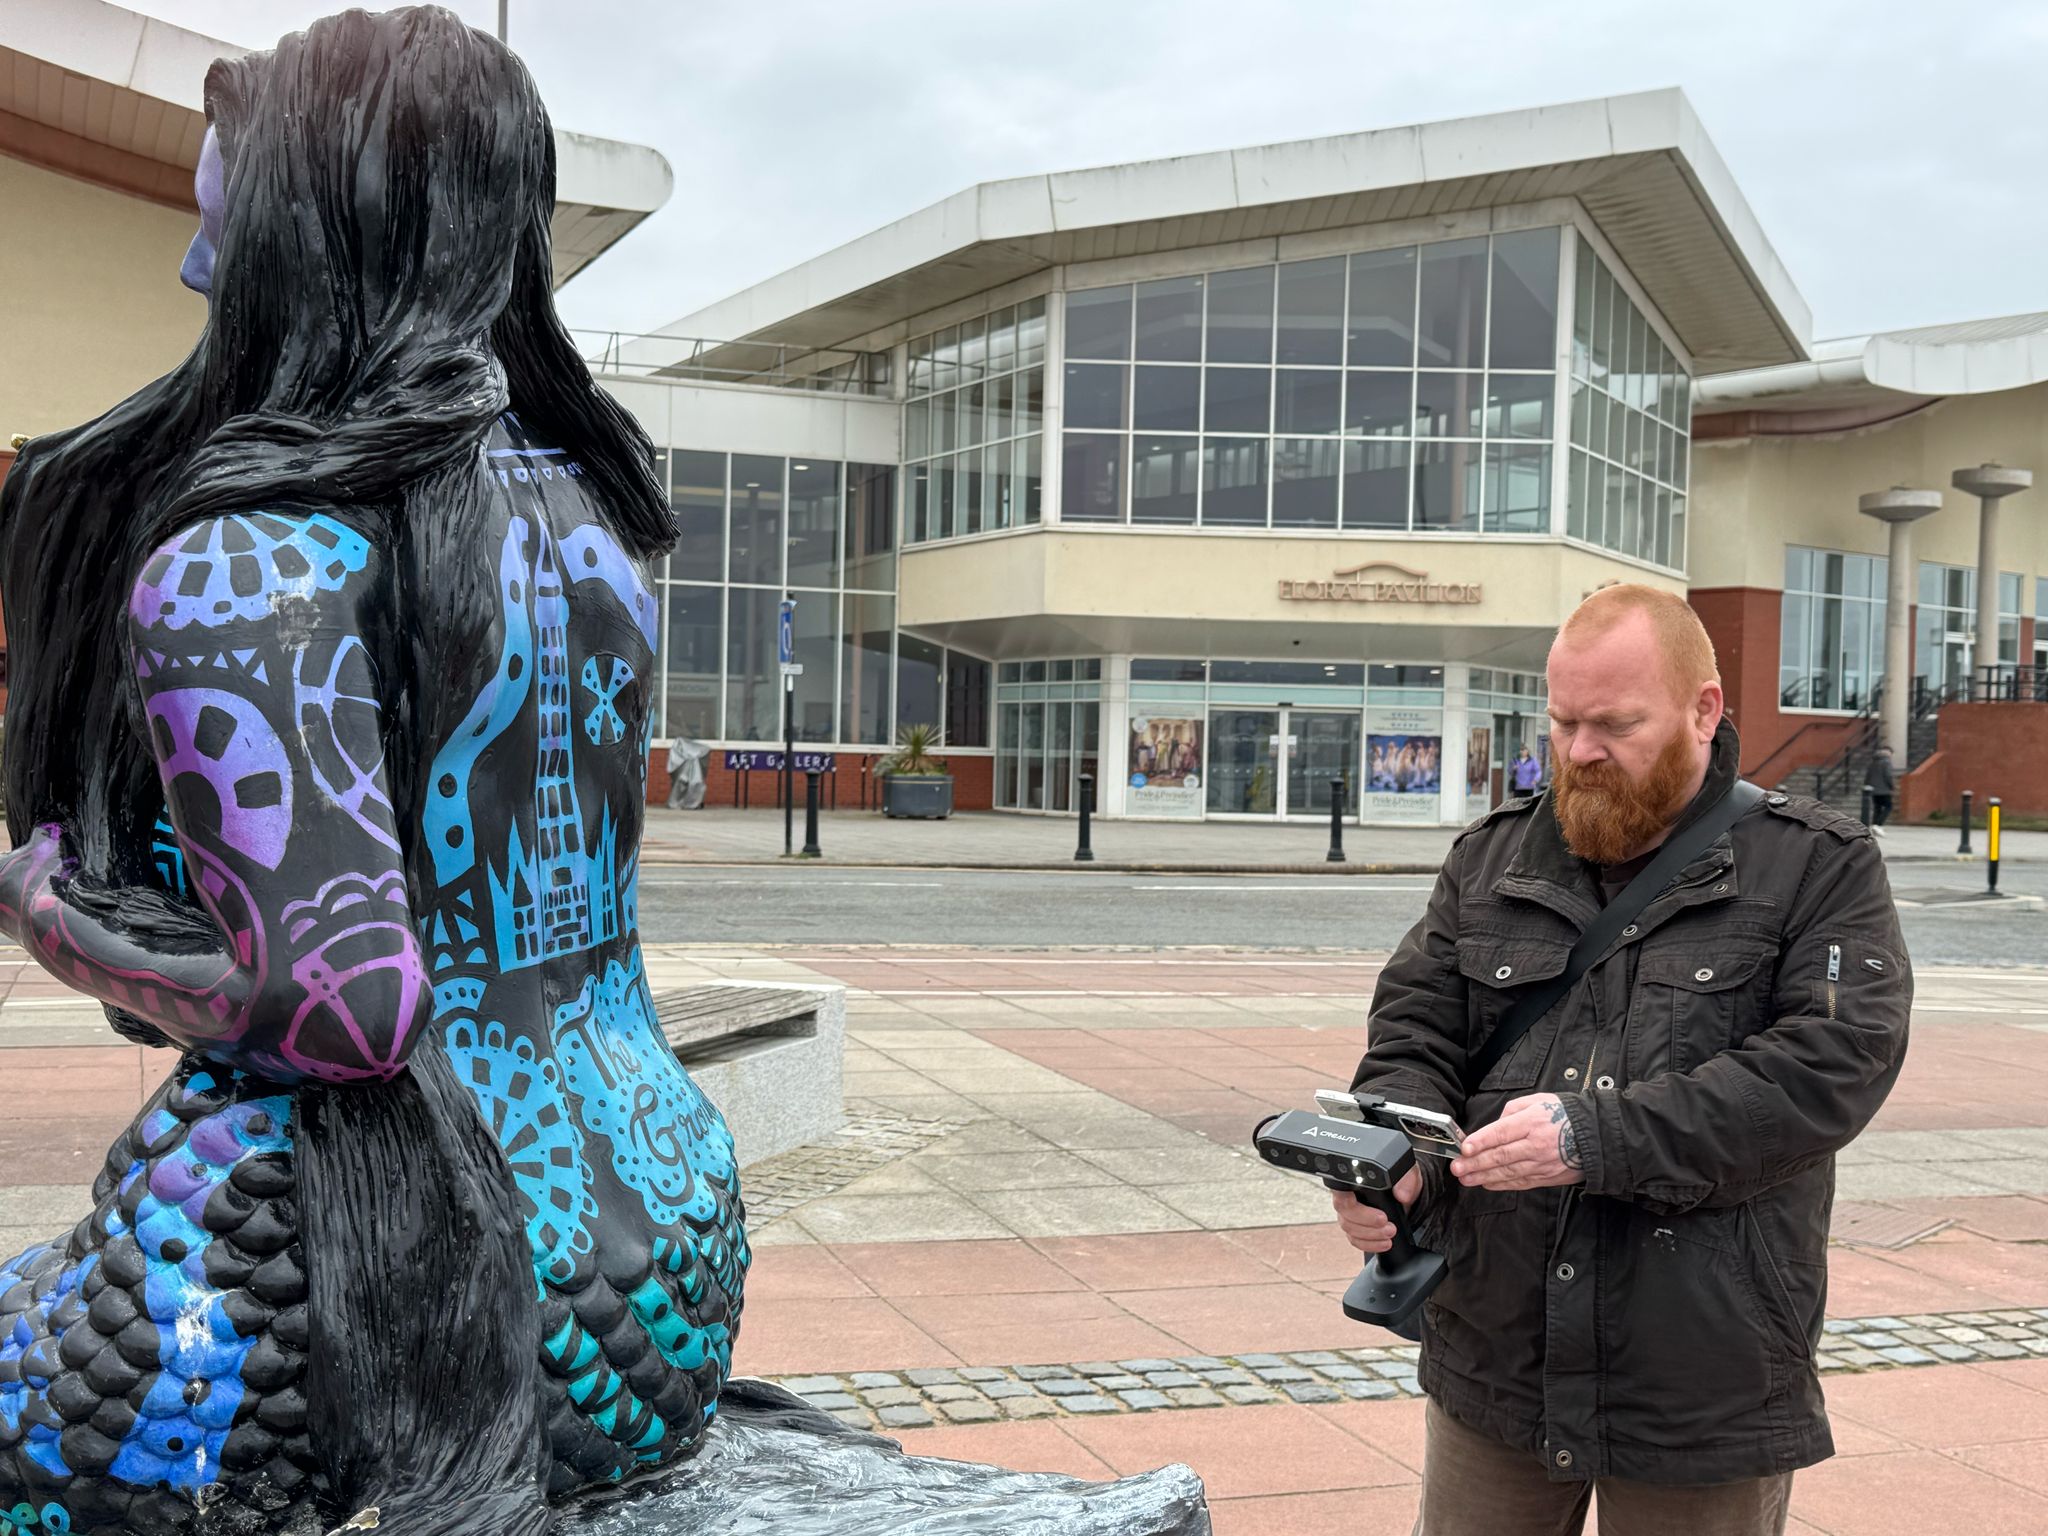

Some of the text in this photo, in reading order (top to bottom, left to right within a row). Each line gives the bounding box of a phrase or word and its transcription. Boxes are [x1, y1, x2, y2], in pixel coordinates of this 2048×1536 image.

[1278, 580, 1483, 604] FLORAL PAVILION
[556, 982, 643, 1091] The
[1320, 1130, 1361, 1144] CREALITY
